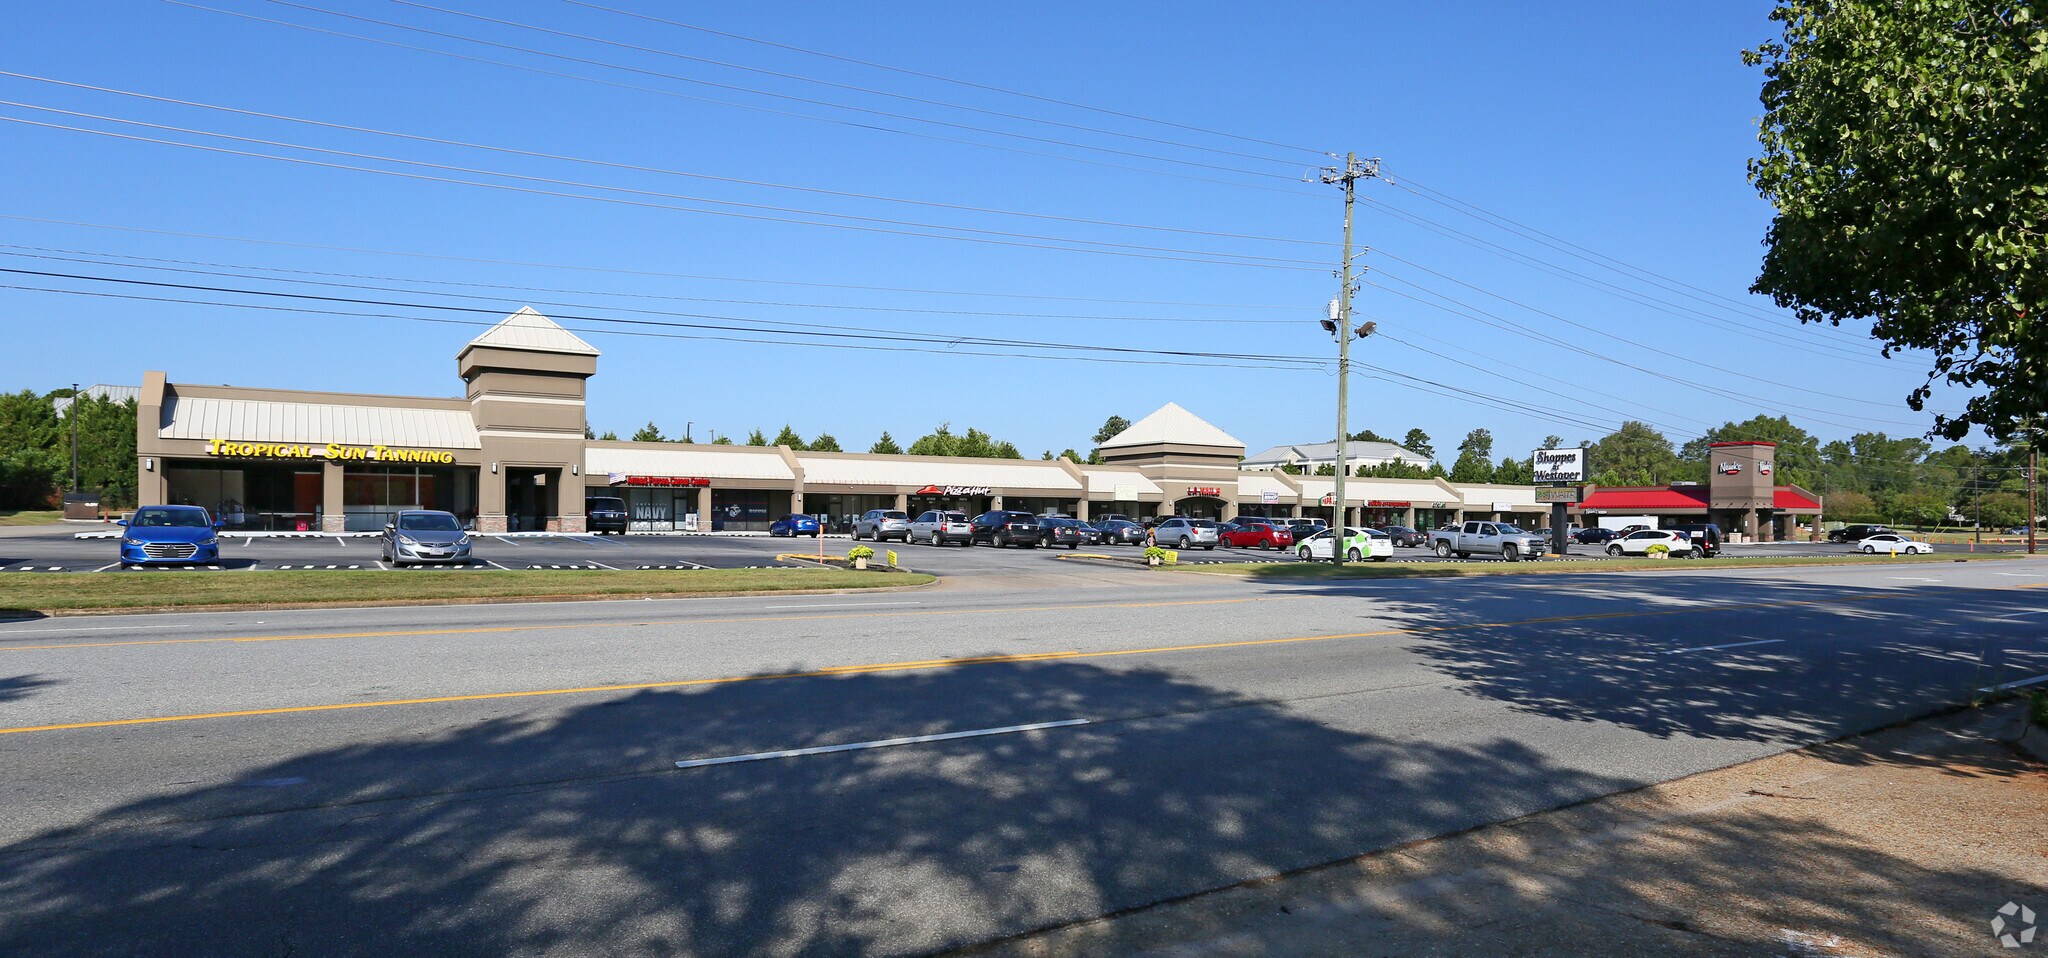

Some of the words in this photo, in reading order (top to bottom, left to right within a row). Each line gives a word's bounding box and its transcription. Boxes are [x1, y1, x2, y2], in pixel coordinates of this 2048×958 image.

[209, 439, 313, 458] TROPICAL
[324, 443, 366, 461] SUN
[372, 445, 453, 465] TANNING
[1536, 451, 1577, 465] Shoppes
[1534, 470, 1581, 480] Westover
[943, 485, 971, 496] Pizza
[970, 486, 991, 496] Hut
[636, 506, 666, 519] NAVY
